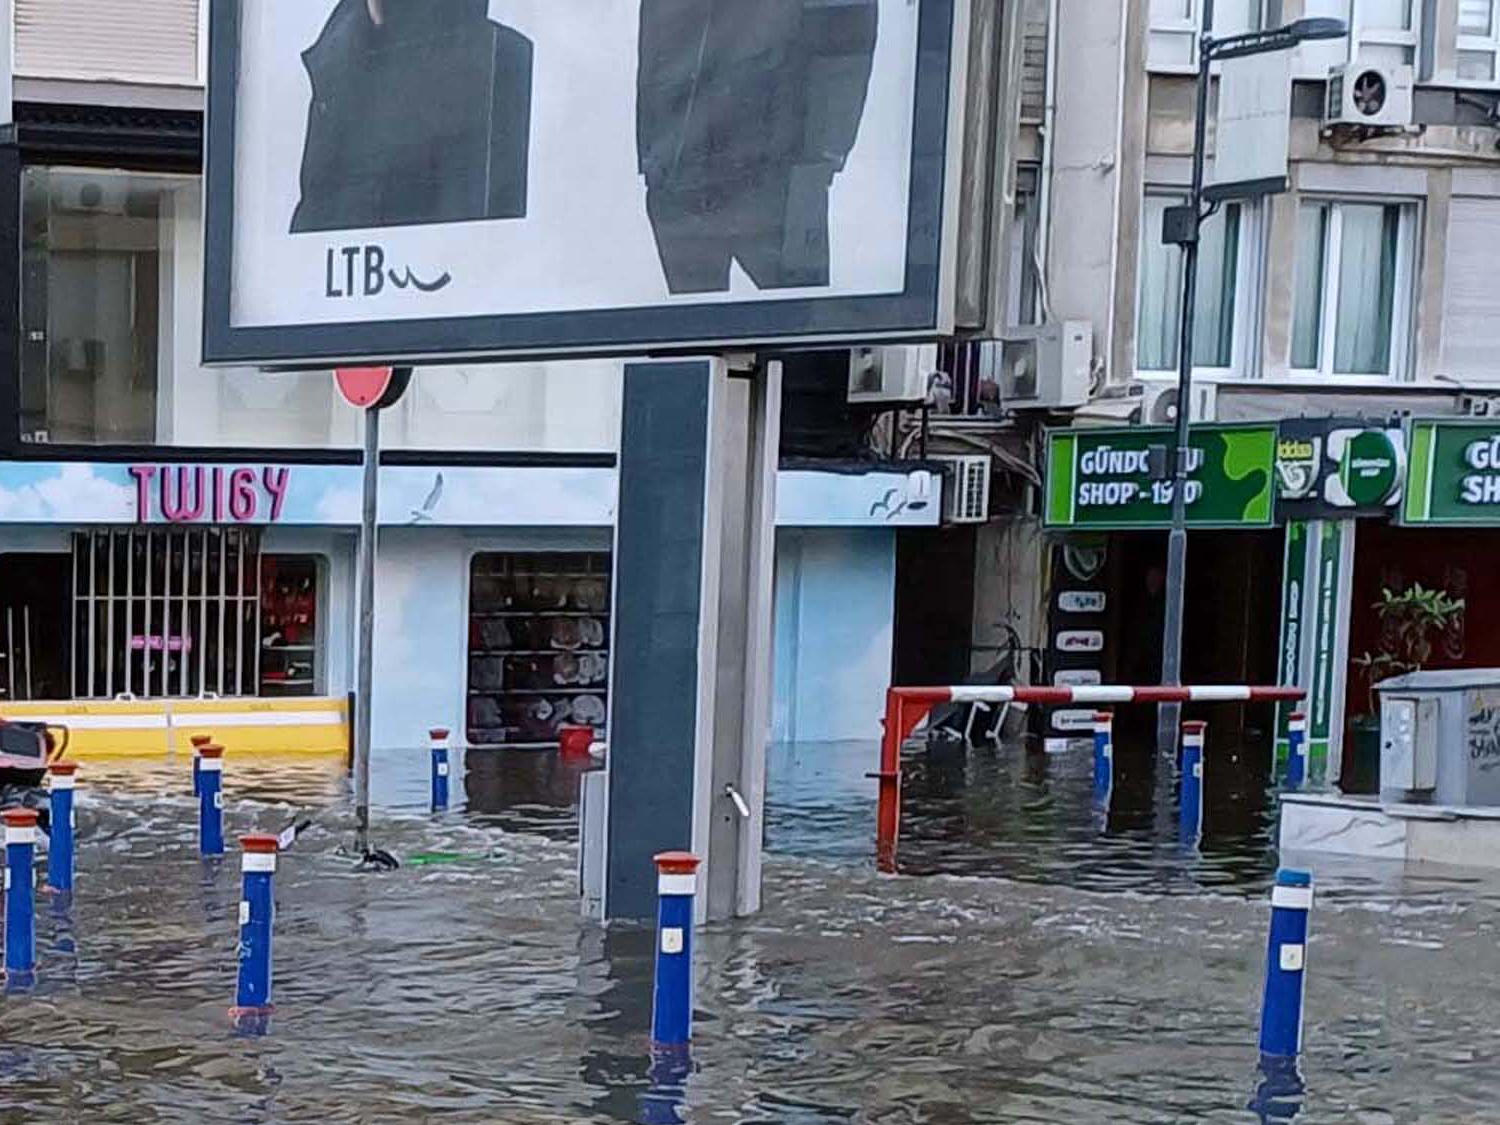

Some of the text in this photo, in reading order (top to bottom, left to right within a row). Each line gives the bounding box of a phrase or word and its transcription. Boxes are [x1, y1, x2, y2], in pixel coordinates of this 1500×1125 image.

[326, 245, 384, 297] LTB
[128, 466, 290, 523] TWIGY
[1078, 482, 1138, 506] SHOP
[1152, 480, 1202, 505] 190
